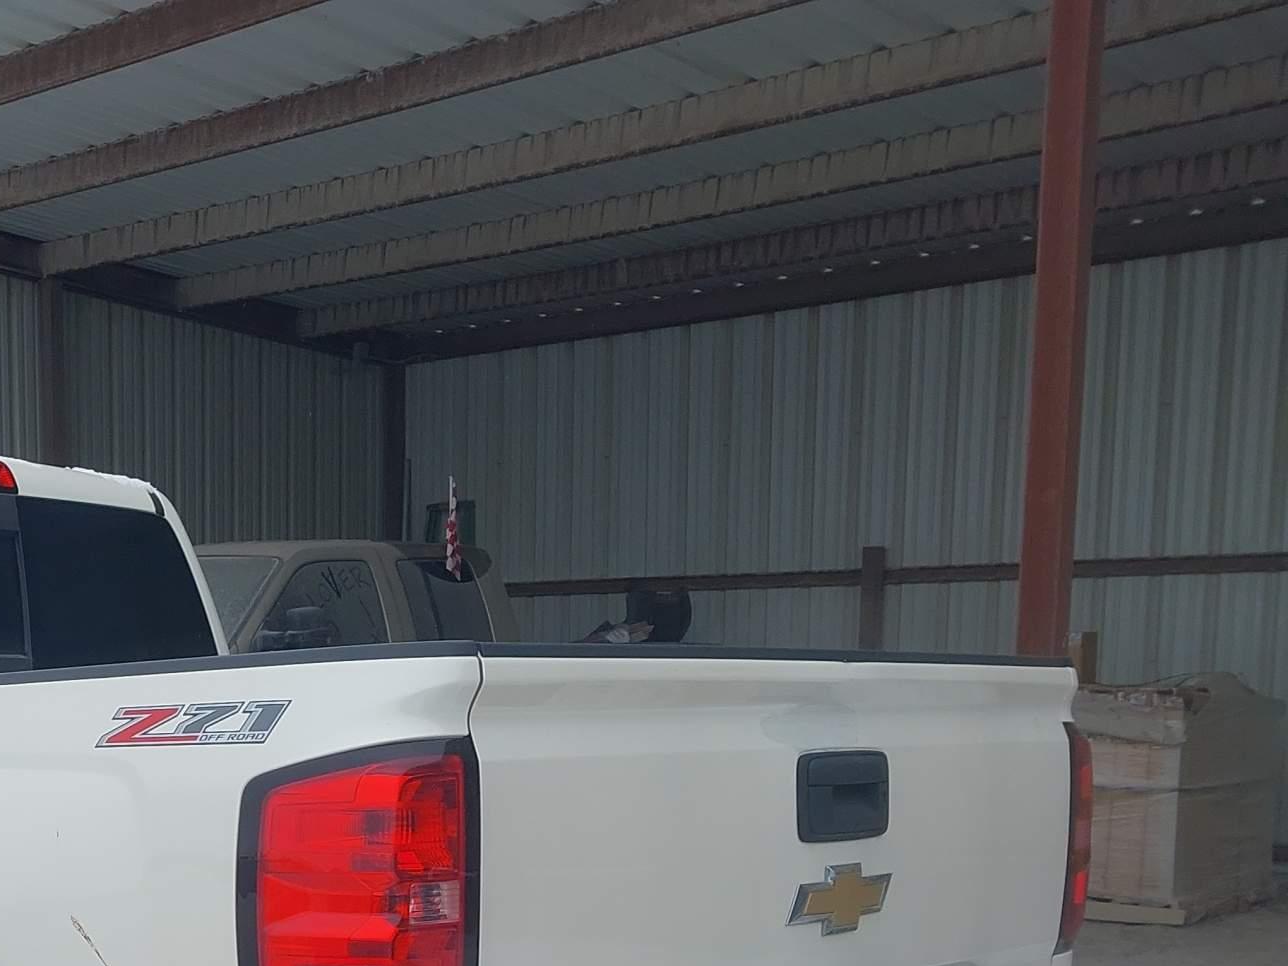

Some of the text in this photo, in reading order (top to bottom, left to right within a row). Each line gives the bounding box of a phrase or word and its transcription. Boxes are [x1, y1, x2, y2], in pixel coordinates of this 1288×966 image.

[95, 700, 292, 748] Z71
[199, 732, 266, 742] OFF ROAD
